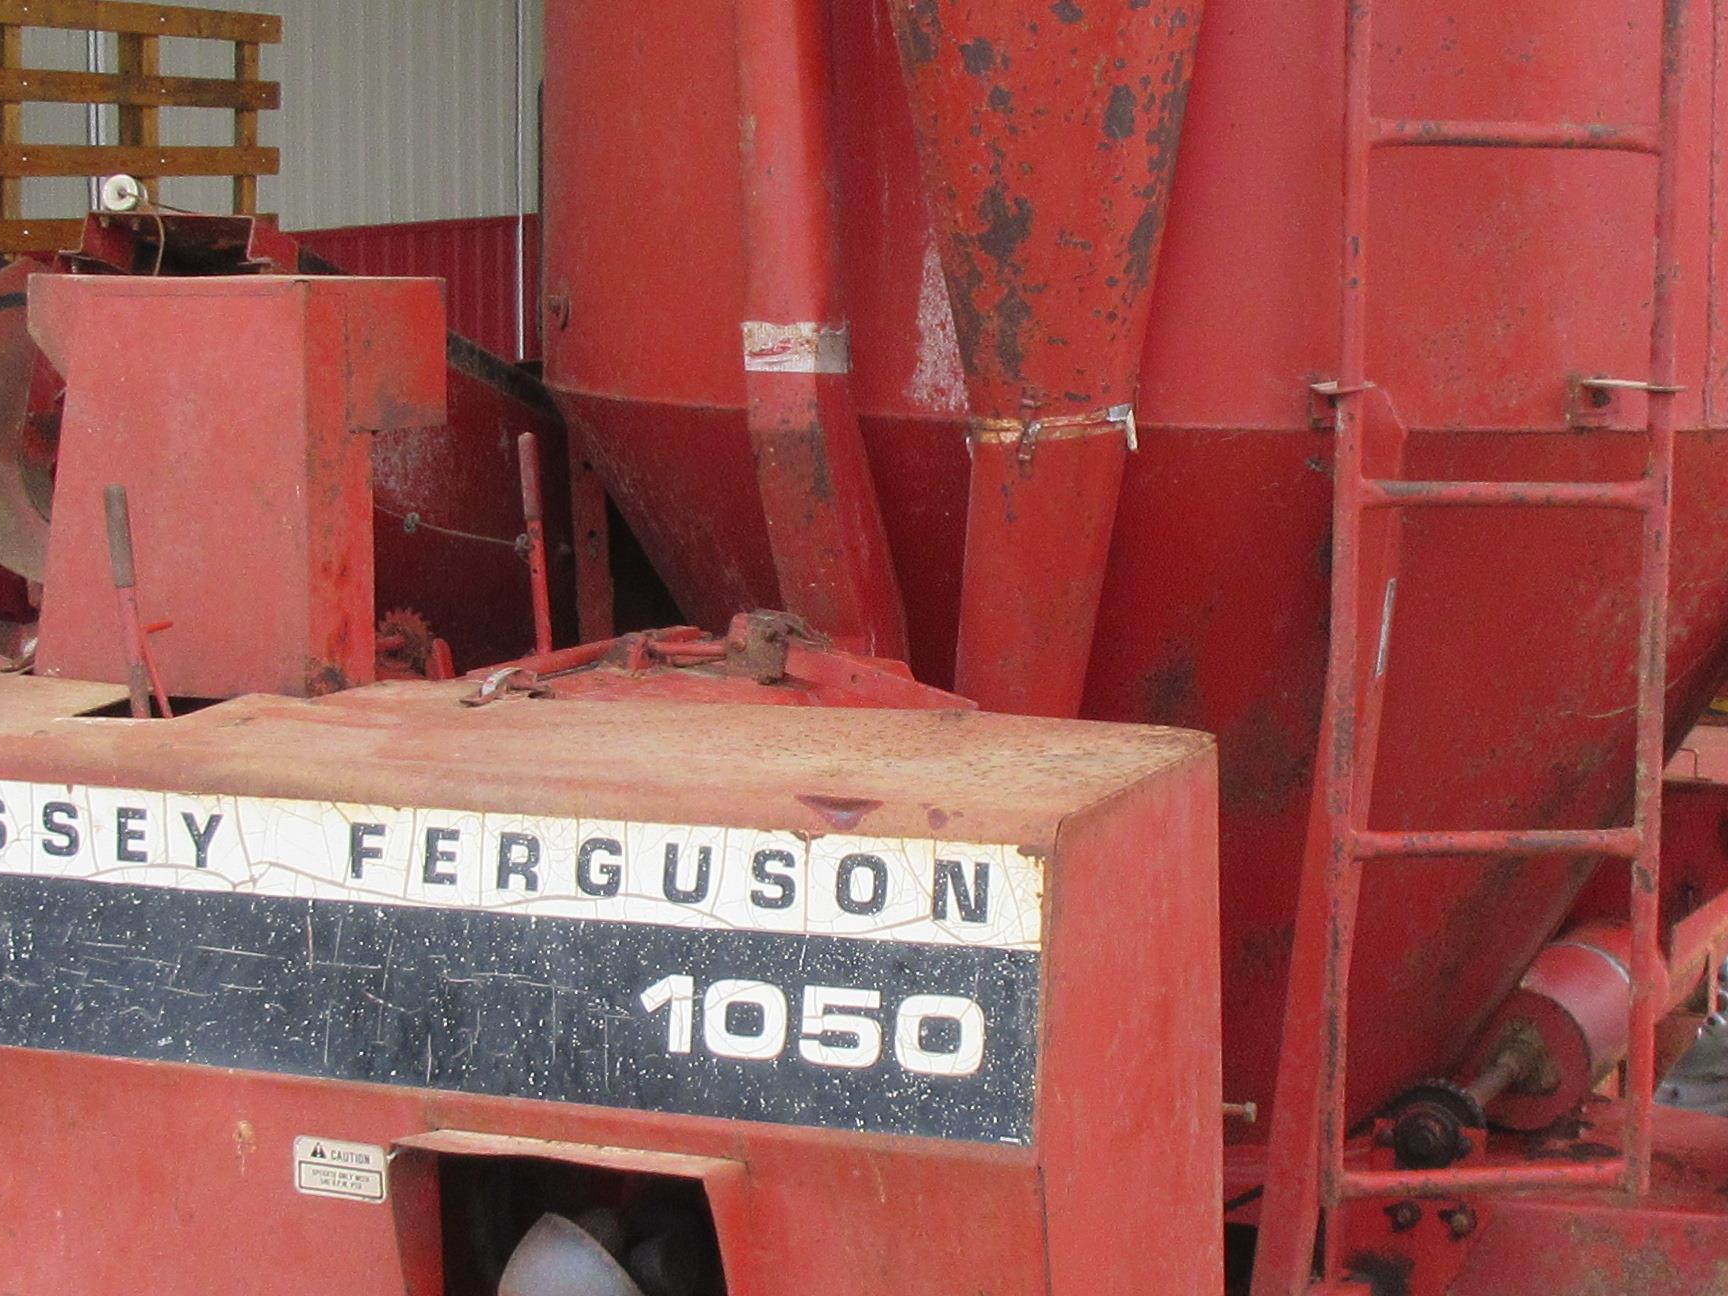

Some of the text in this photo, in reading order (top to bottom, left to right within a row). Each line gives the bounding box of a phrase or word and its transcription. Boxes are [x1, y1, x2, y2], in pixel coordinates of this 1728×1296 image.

[349, 822, 991, 924] FERGUSON
[639, 974, 985, 1076] 1050
[330, 1150, 370, 1165] CAUTION
